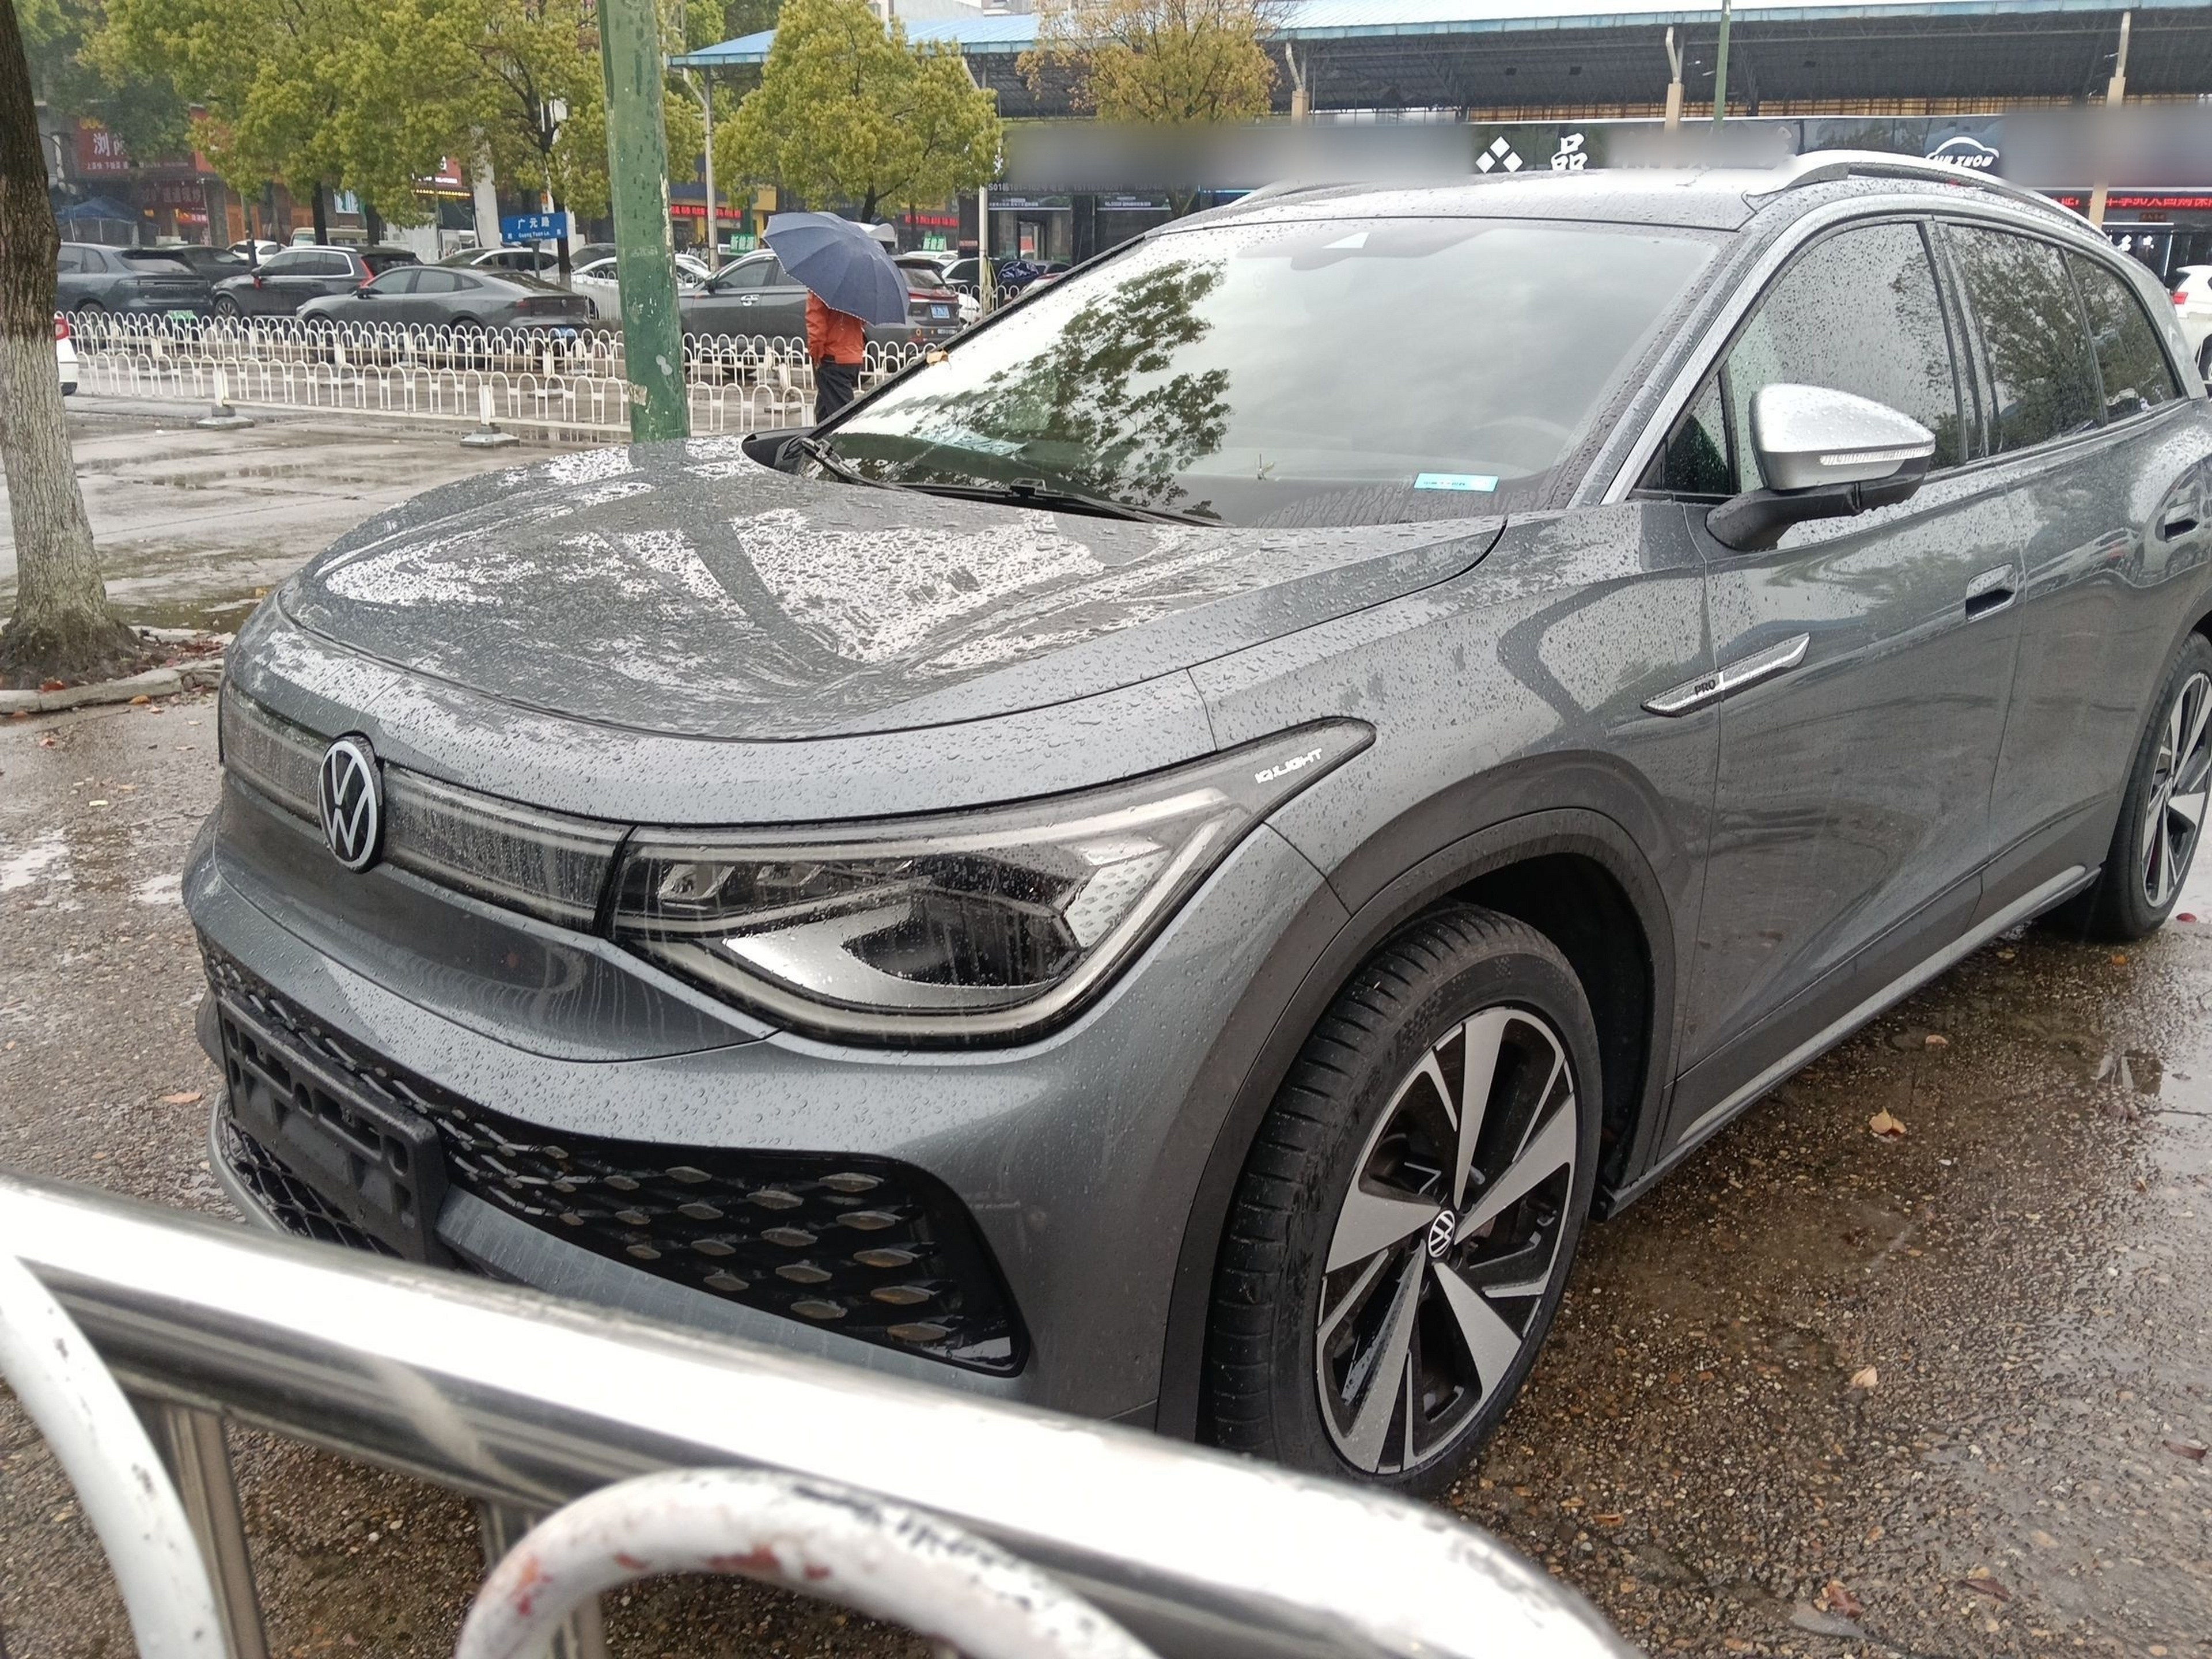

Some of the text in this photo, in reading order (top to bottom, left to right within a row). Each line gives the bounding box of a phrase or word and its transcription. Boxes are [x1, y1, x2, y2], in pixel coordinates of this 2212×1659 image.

[1551, 133, 1588, 170] 品
[518, 216, 550, 229] 广元路
[1694, 679, 1716, 696] PRO
